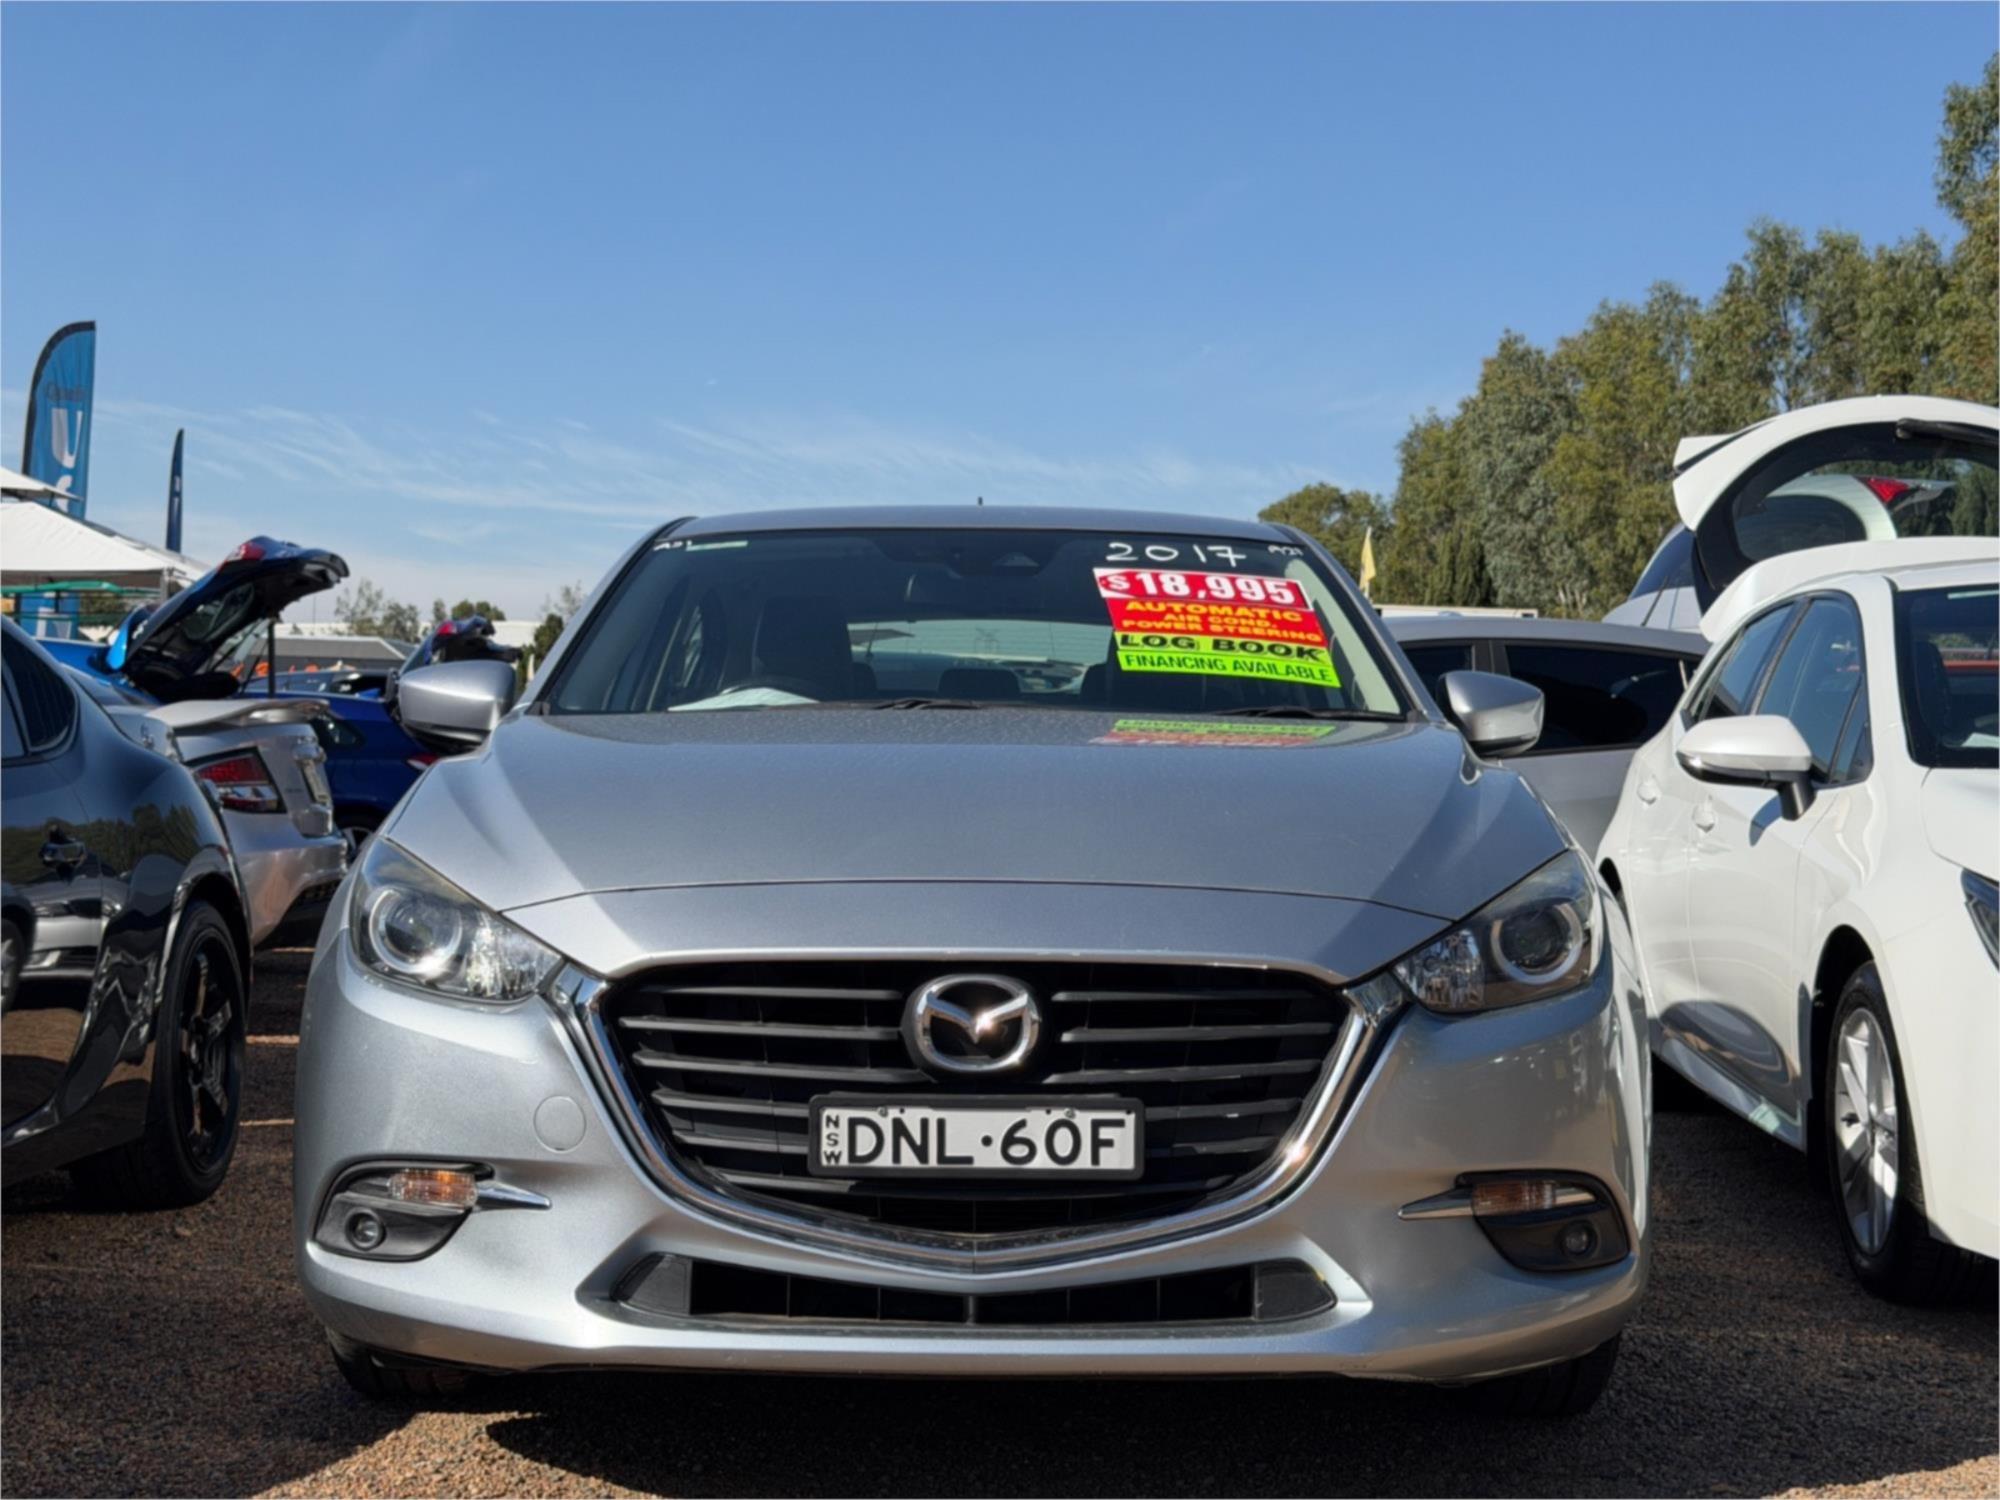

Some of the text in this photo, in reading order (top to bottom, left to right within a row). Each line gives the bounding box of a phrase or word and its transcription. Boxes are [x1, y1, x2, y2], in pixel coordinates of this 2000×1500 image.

[1105, 542, 1247, 567] 2017
[1106, 572, 1296, 604] $18,995
[1125, 601, 1303, 623] AUTOMATIC
[1164, 612, 1278, 629] AIR COND.
[1121, 619, 1323, 643] POWER STEERING
[1120, 634, 1325, 662] LOG BOOK
[1125, 654, 1333, 683] FINANCING AVAILABLE
